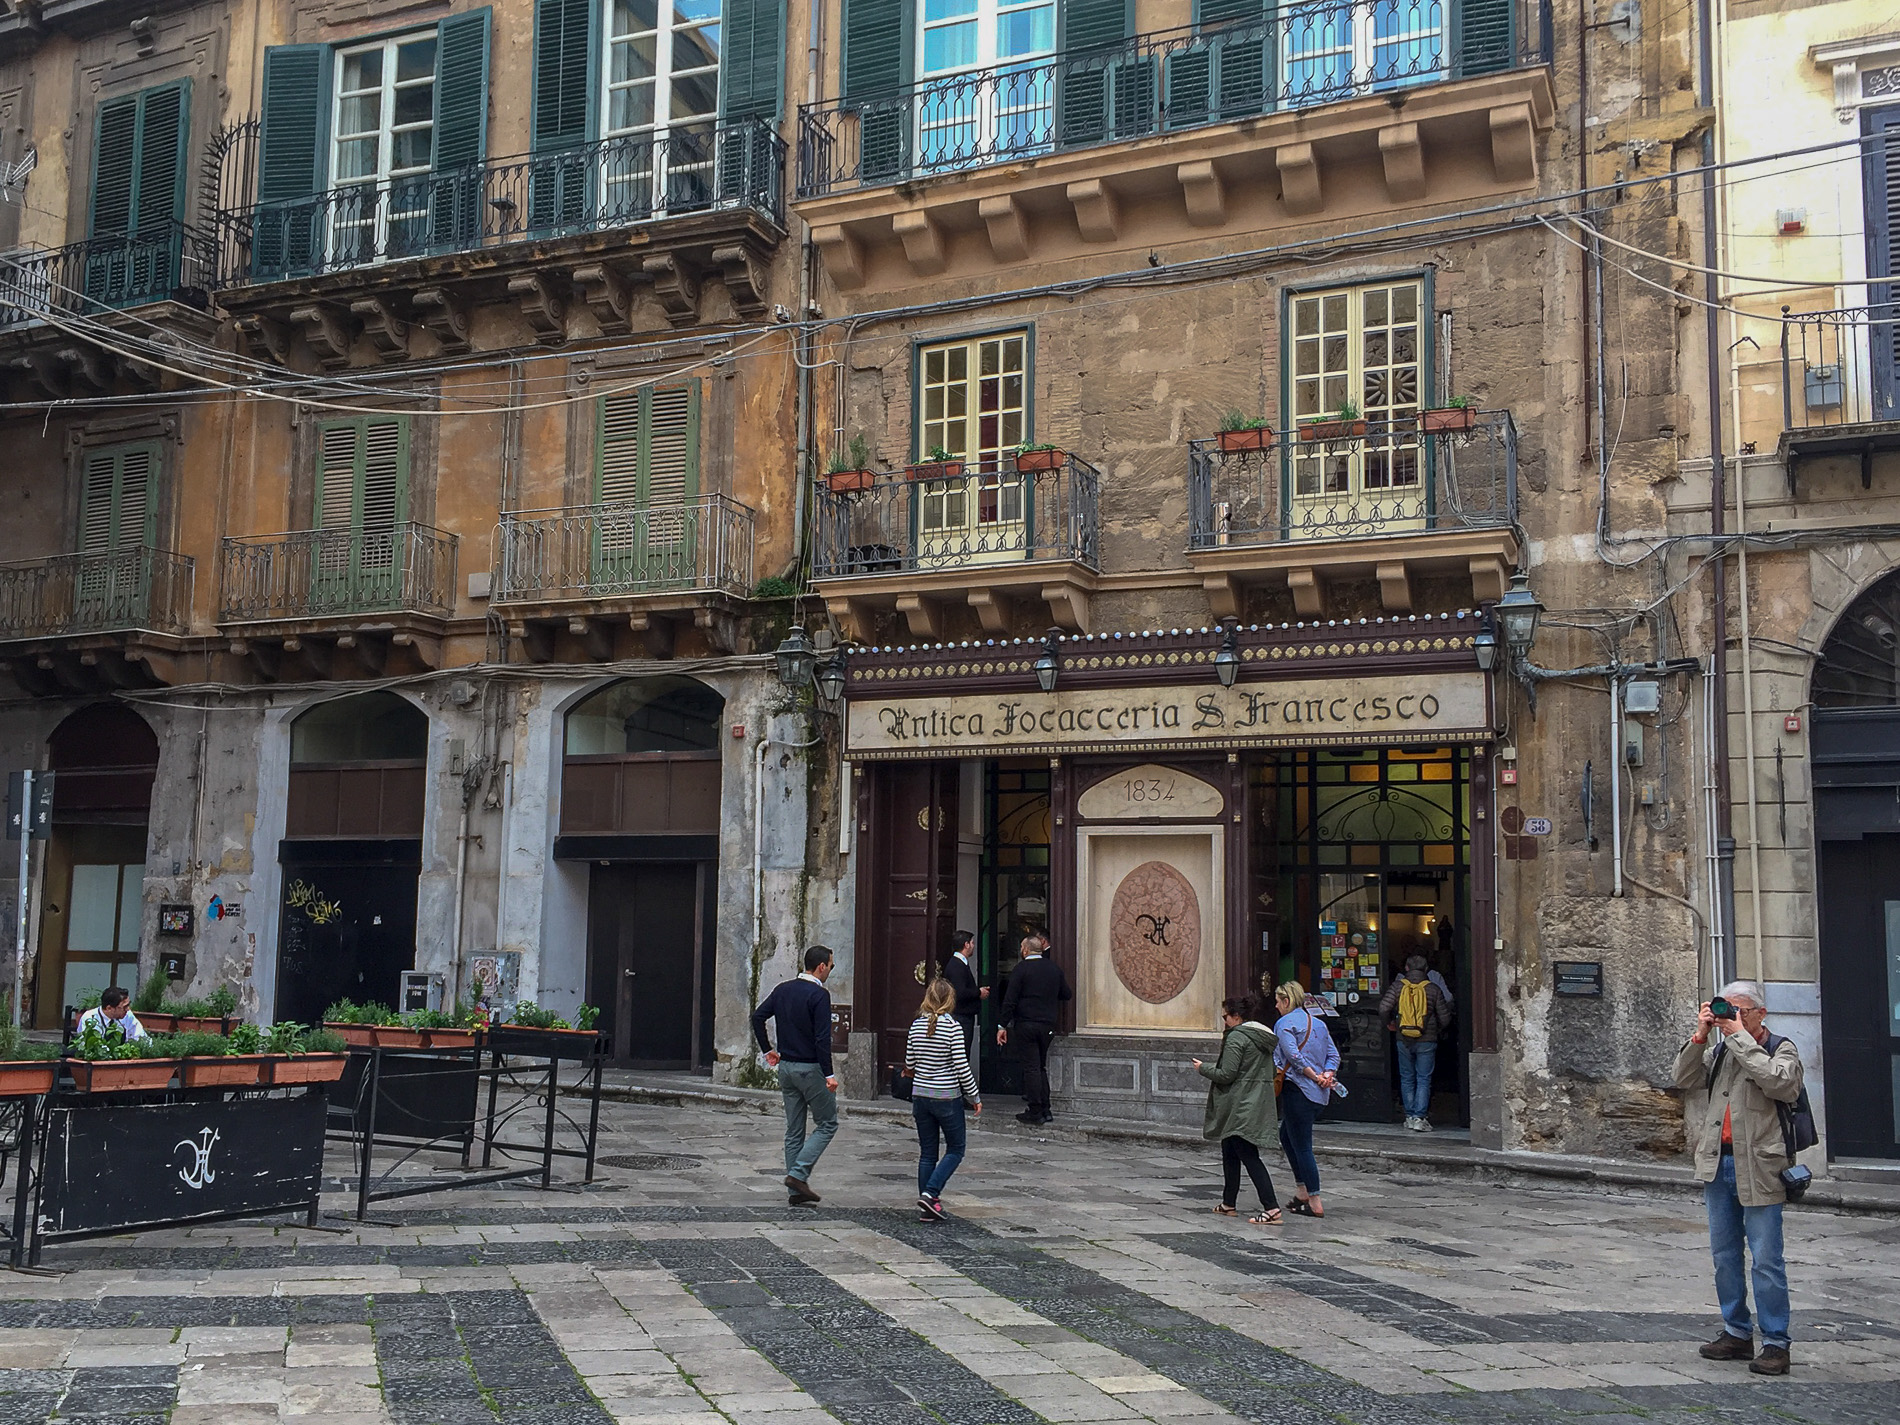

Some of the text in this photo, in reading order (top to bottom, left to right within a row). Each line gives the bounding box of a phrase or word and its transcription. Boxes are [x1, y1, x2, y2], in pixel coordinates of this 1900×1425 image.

[879, 691, 1439, 740] Antica Focacceria S. Francesco
[1123, 779, 1175, 801] 1834
[1531, 820, 1545, 832] 58
